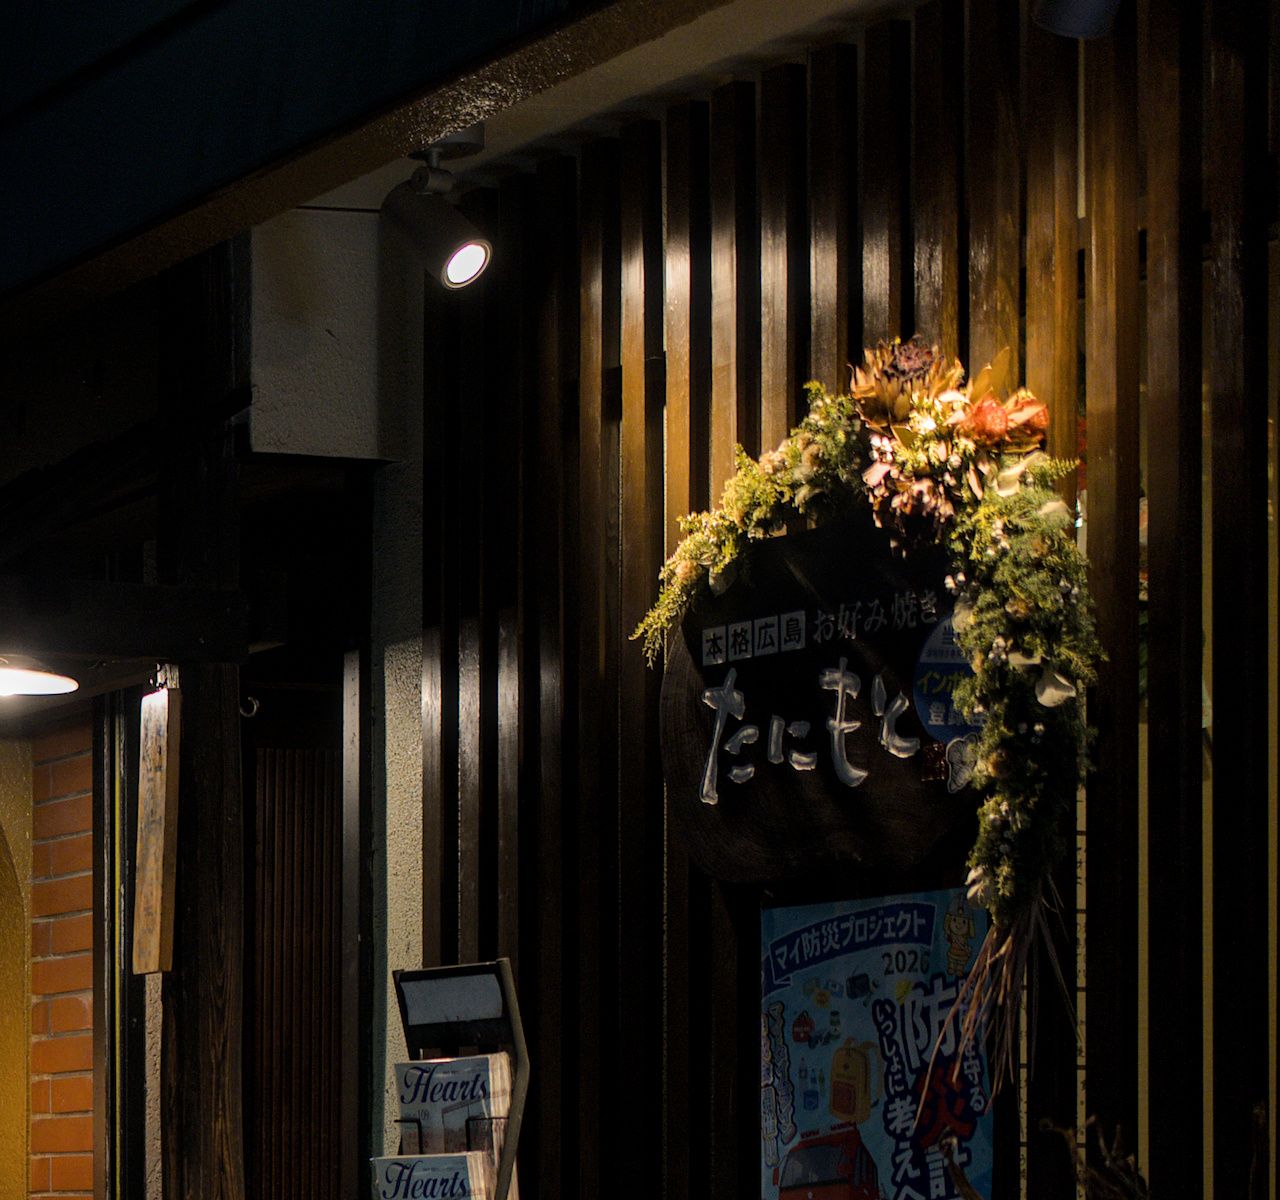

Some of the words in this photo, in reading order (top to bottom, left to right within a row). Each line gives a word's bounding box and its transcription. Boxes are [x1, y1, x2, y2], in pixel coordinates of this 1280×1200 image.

[702, 609, 807, 667] 本格広島
[812, 590, 938, 643] お好み焼き
[699, 655, 921, 806] たにもと
[774, 907, 927, 970] マイ防災プロジェクト
[400, 1063, 488, 1105] Hearts
[382, 1159, 468, 1200] Hearts
